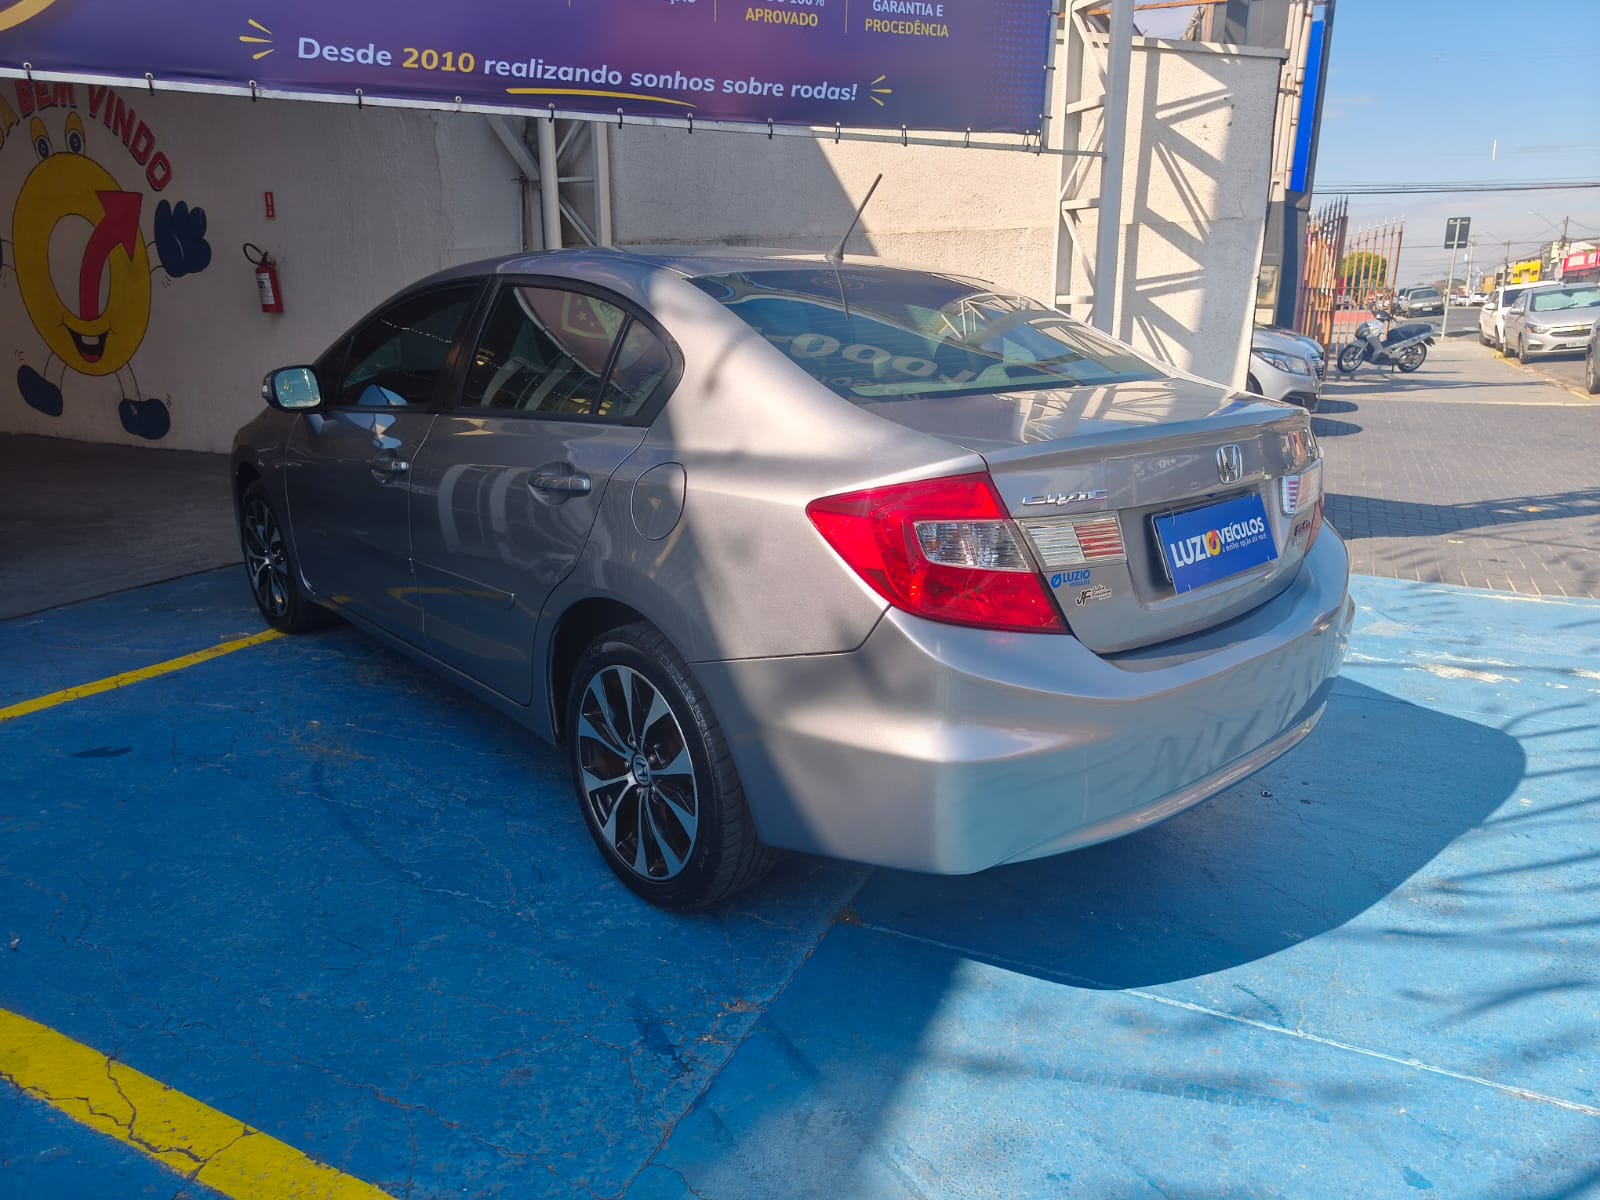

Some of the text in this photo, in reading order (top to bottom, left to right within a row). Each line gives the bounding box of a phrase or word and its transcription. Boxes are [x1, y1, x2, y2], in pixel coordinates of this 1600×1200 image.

[745, 7, 818, 27] APROVADO
[872, 0, 944, 17] GARANTIA E
[865, 18, 949, 38] PROCEDÊNCIA
[298, 37, 858, 101] Desde 2010 realizando sonhos sobre rodas!
[15, 80, 77, 119] BEM
[88, 84, 173, 192] VINDO
[1170, 529, 1222, 568] LUZIO
[1216, 517, 1265, 544] VEÍCULOS
[1063, 569, 1091, 583] LUZIO
